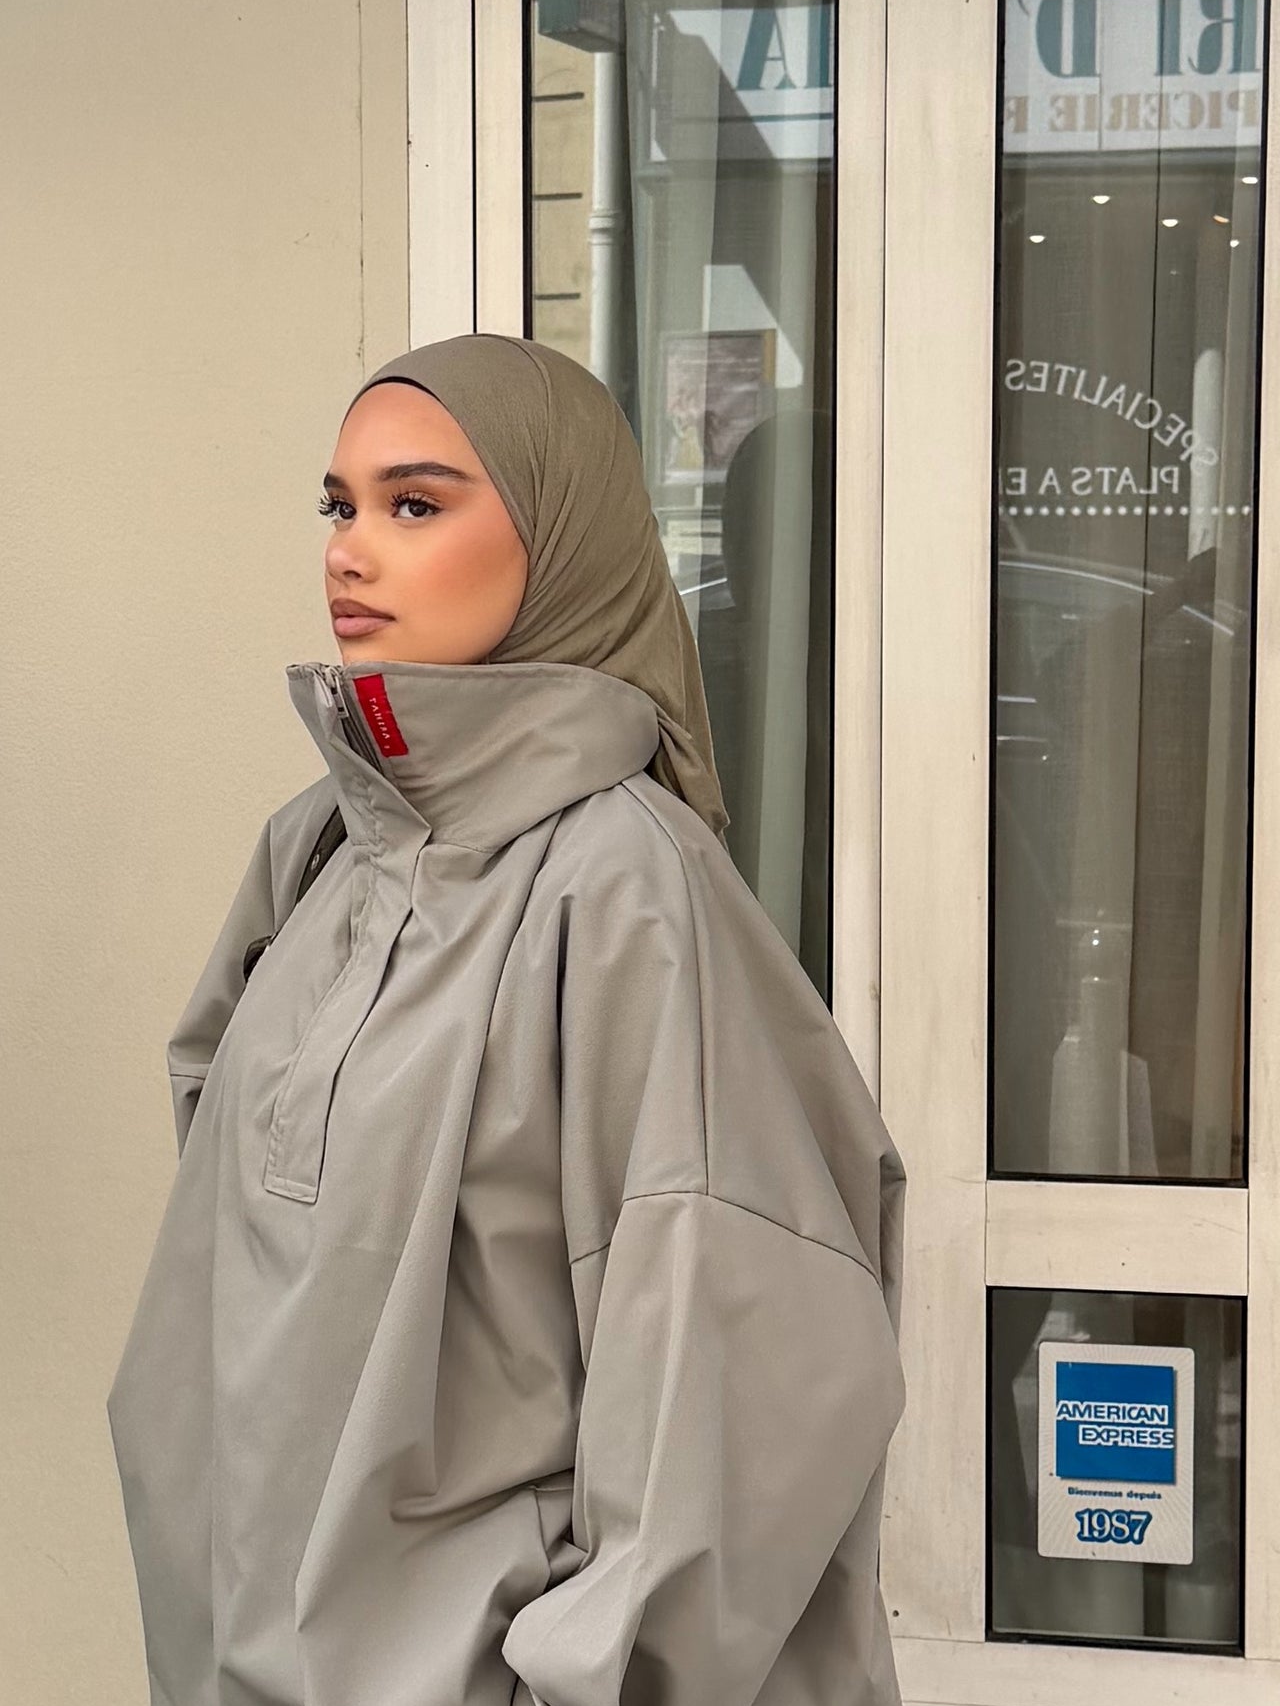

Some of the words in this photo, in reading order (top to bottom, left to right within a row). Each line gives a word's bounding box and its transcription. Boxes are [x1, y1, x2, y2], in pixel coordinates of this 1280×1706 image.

[1056, 1401, 1167, 1424] AMERICAN
[1080, 1425, 1174, 1447] EXPRESS
[1075, 1508, 1152, 1545] 1987
